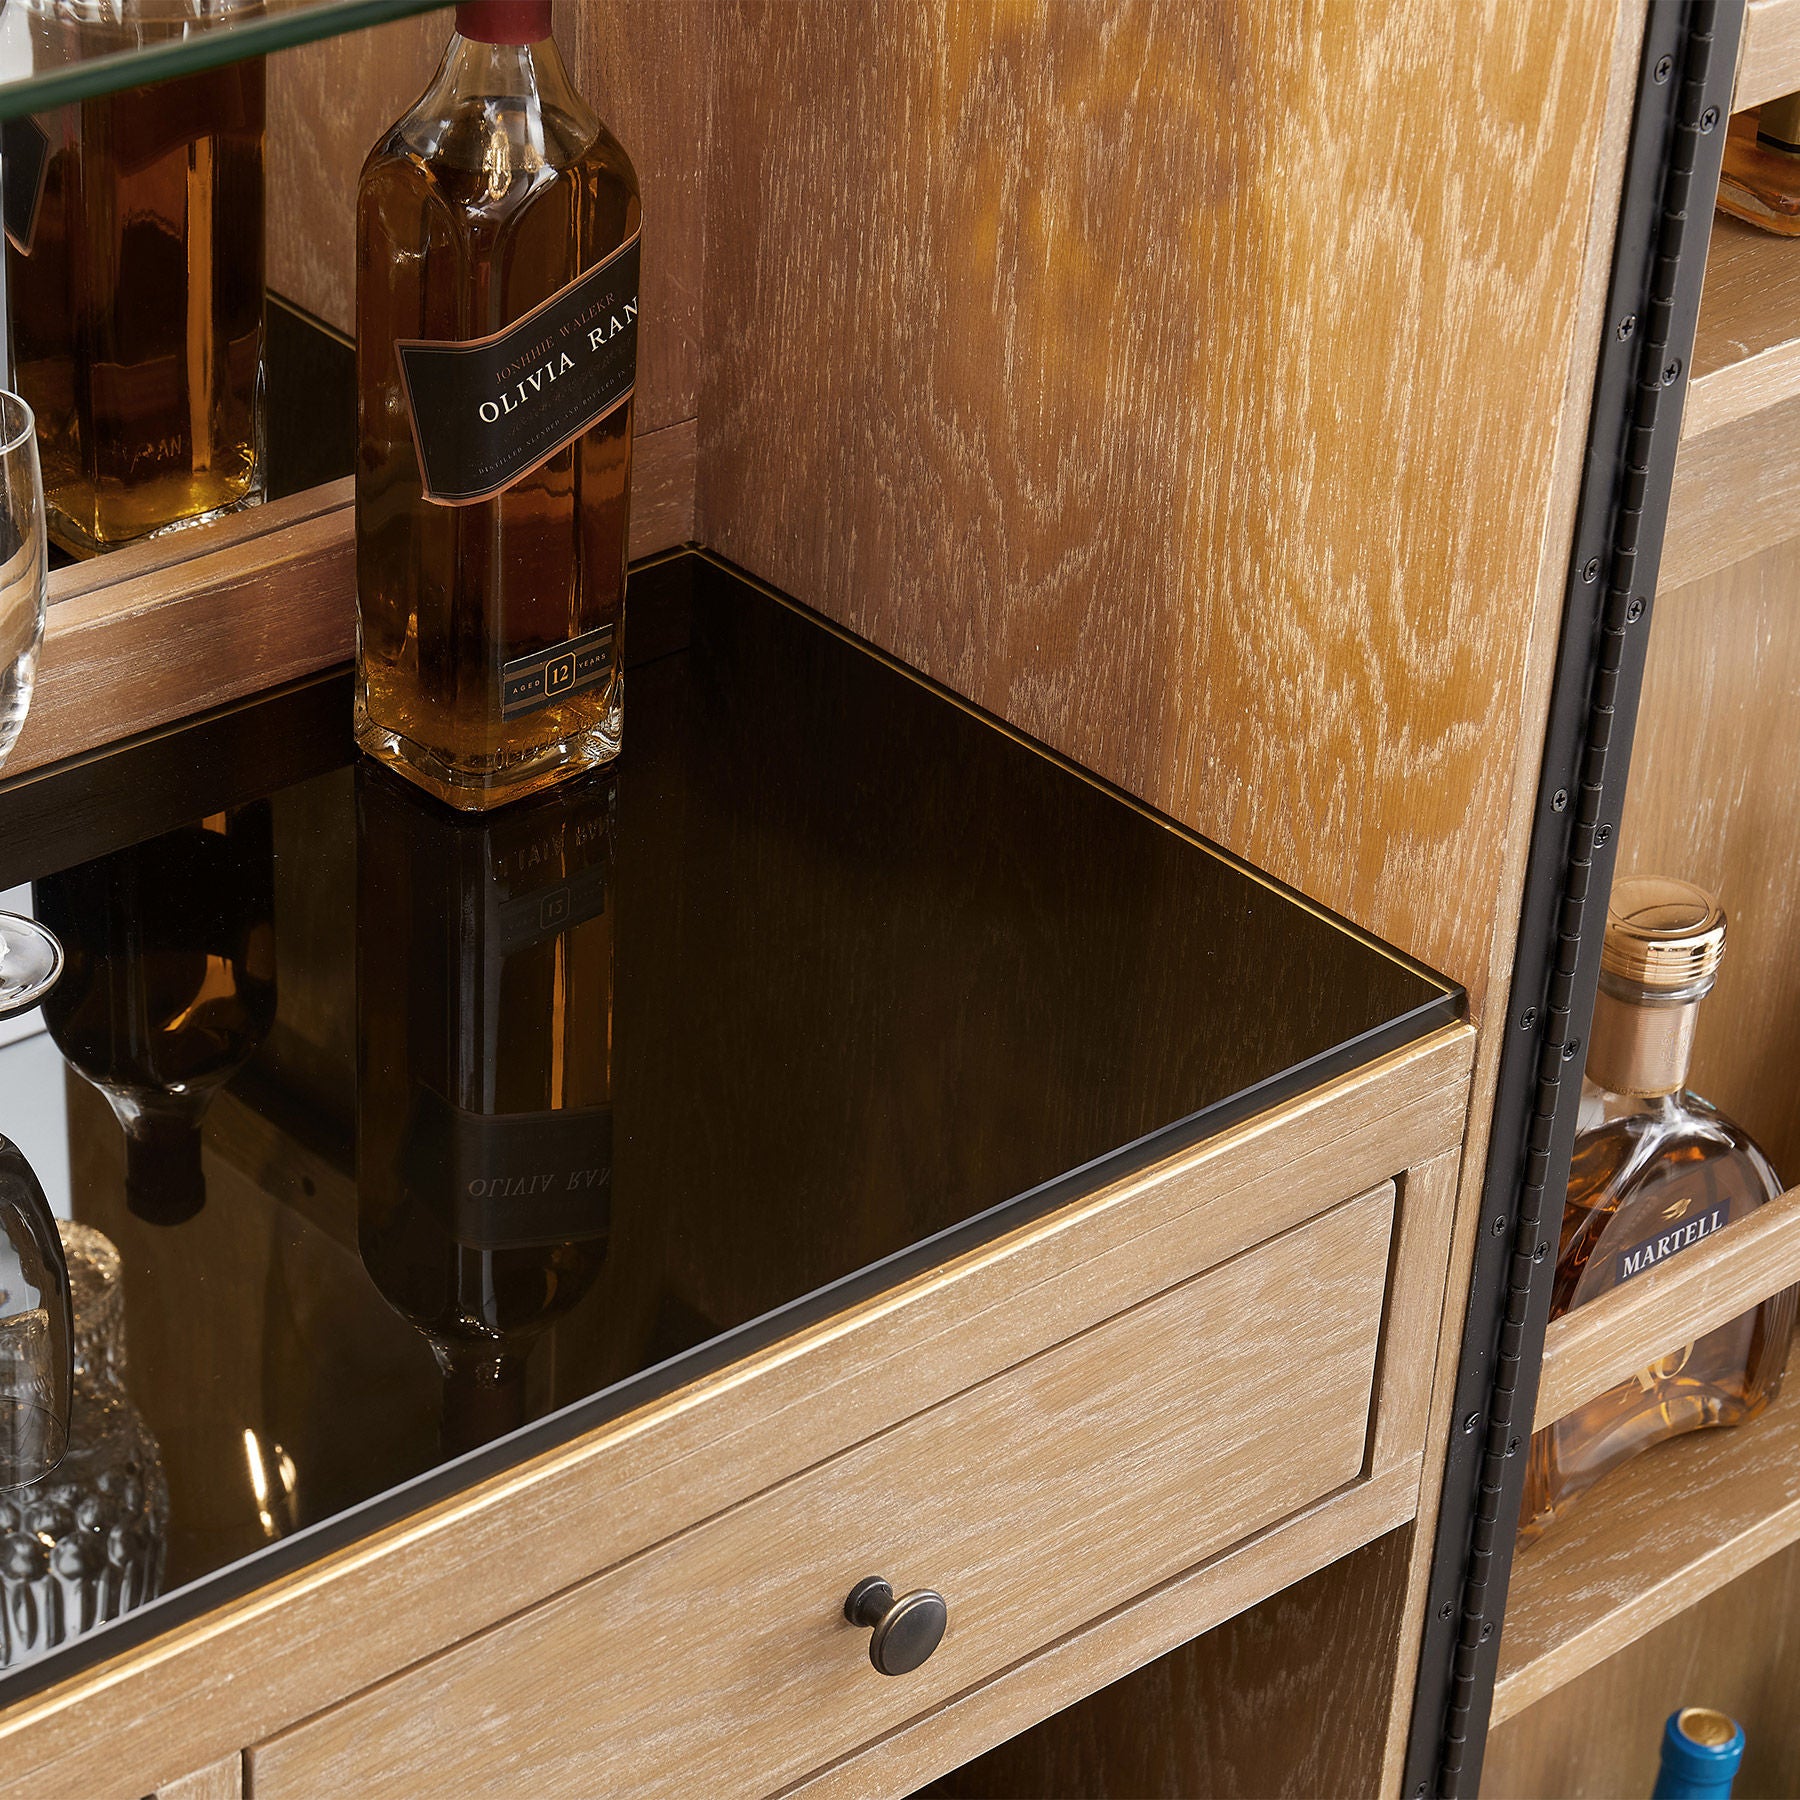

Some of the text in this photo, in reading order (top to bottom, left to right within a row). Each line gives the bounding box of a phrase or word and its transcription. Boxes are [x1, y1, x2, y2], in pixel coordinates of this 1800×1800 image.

[479, 352, 576, 424] OLIVIA
[587, 296, 639, 352] RAN
[552, 665, 569, 685] 12
[578, 653, 606, 668] YEARS
[1621, 1210, 1723, 1279] MARTELL
